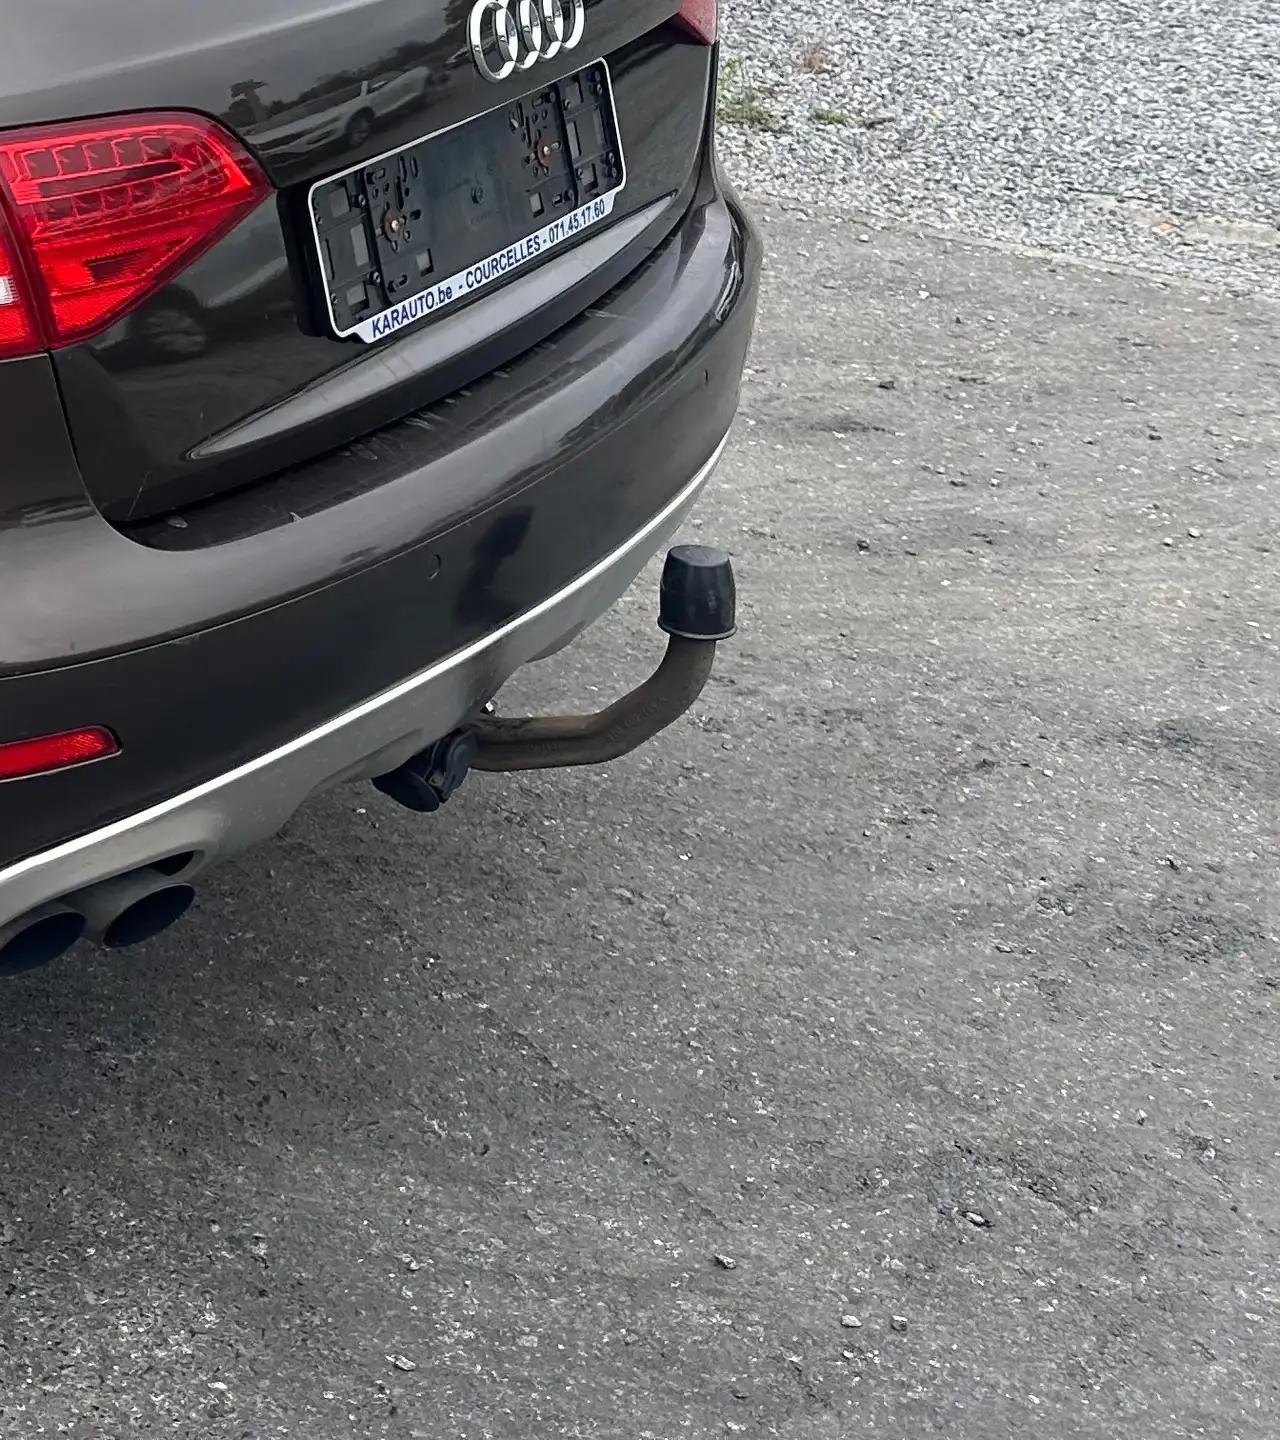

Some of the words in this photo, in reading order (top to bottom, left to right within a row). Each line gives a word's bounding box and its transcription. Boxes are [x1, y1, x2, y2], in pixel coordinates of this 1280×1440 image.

[371, 286, 454, 338] KARAUTO.be
[465, 234, 541, 289] COURCELLES
[548, 199, 606, 245] 071.45.17.60
